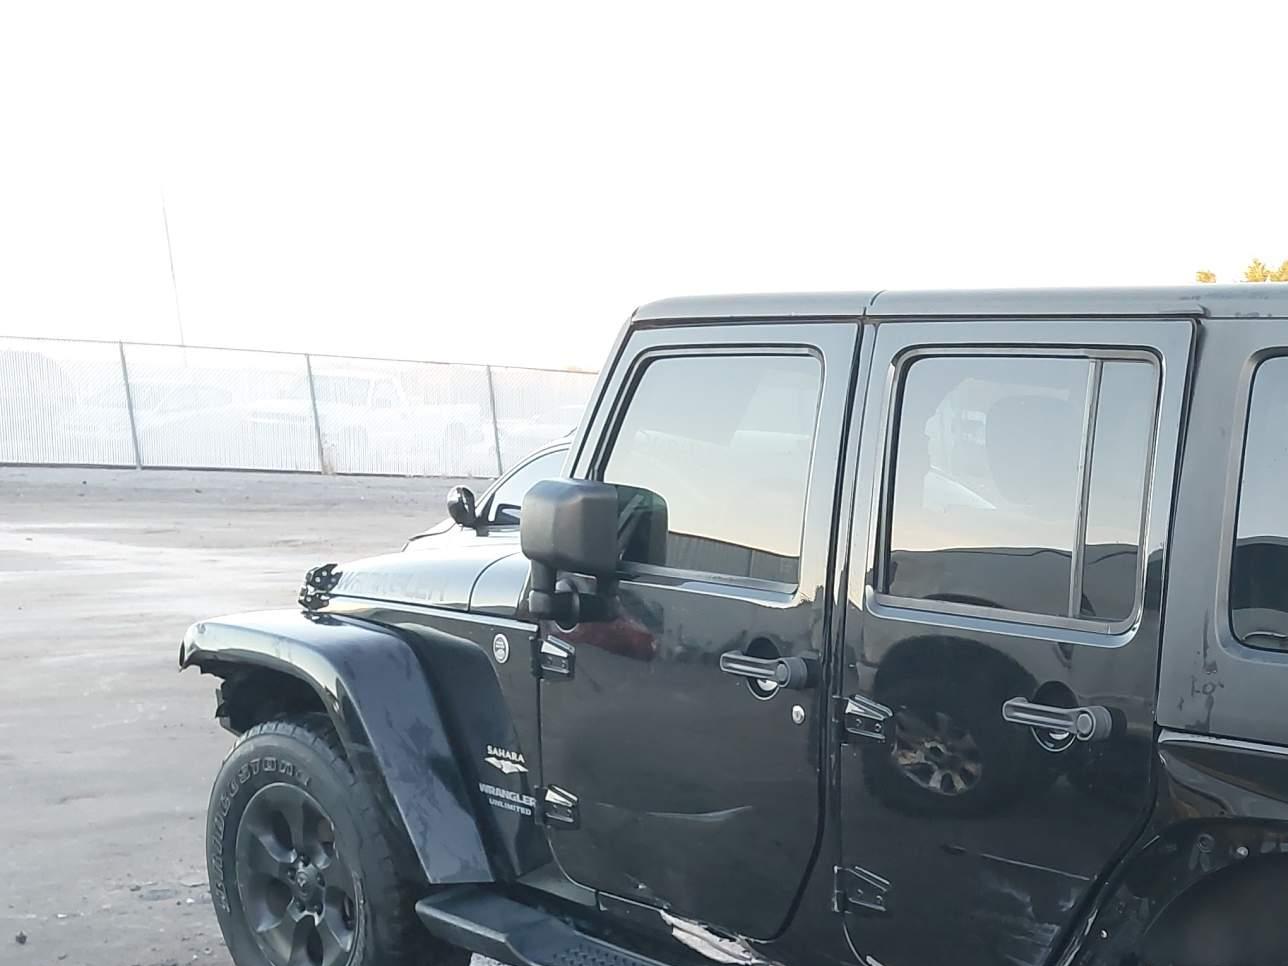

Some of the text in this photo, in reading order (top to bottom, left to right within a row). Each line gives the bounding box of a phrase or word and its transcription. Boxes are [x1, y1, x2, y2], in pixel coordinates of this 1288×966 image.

[487, 745, 525, 763] SAHARA
[479, 783, 536, 808] WRANGLER
[488, 798, 532, 816] UNLIMITED
